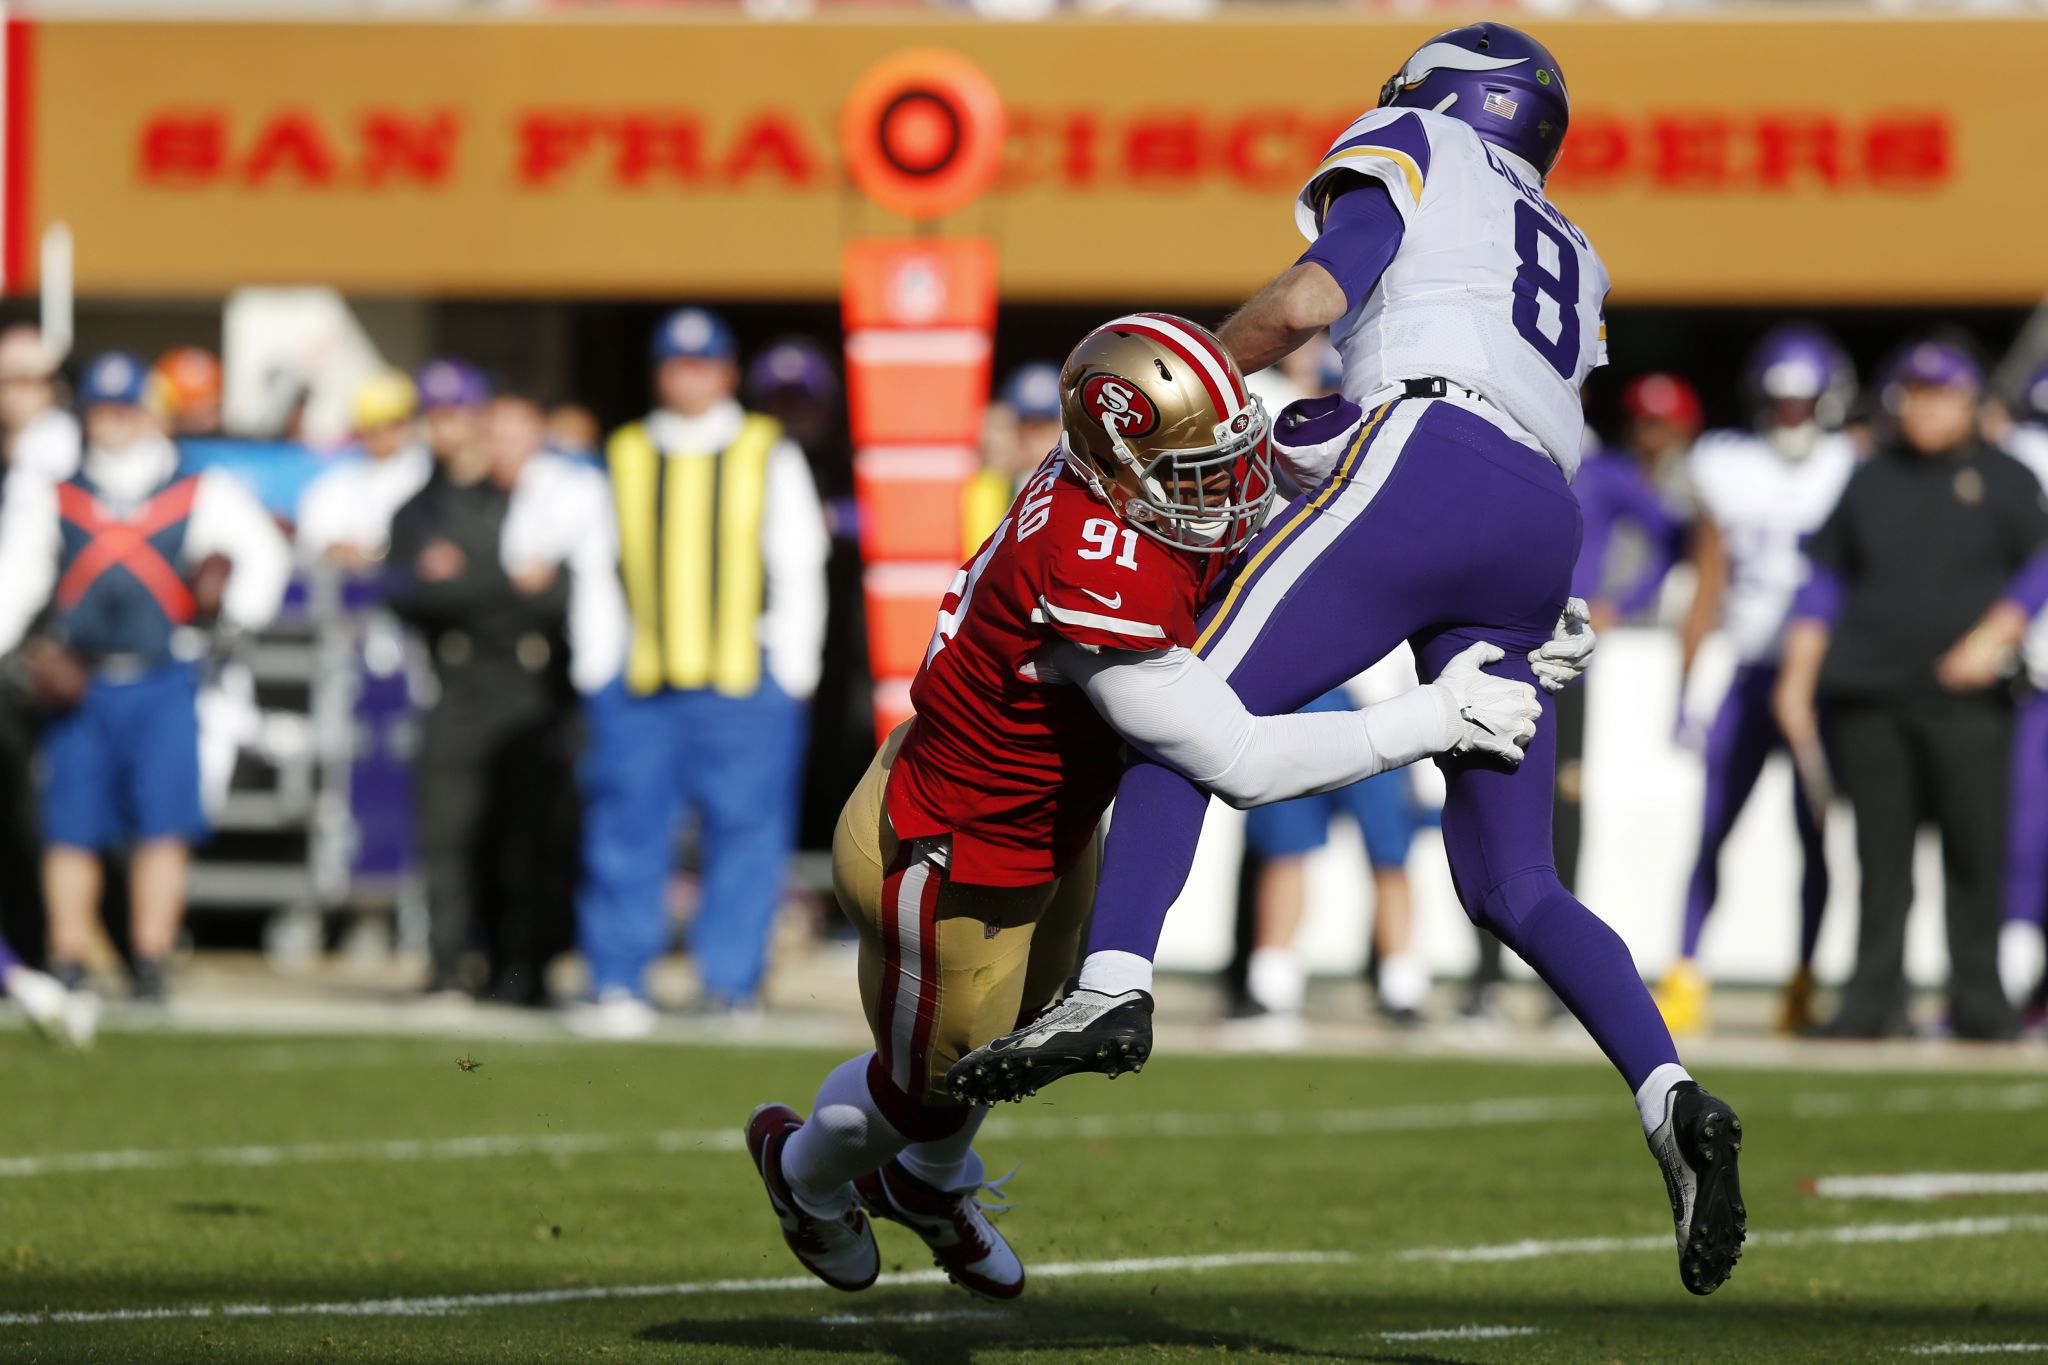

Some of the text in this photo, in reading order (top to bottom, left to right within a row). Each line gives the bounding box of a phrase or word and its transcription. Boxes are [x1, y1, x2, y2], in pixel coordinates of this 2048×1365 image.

[139, 104, 462, 190] SAN
[1513, 198, 1580, 380] 8
[1077, 518, 1139, 571] 91
